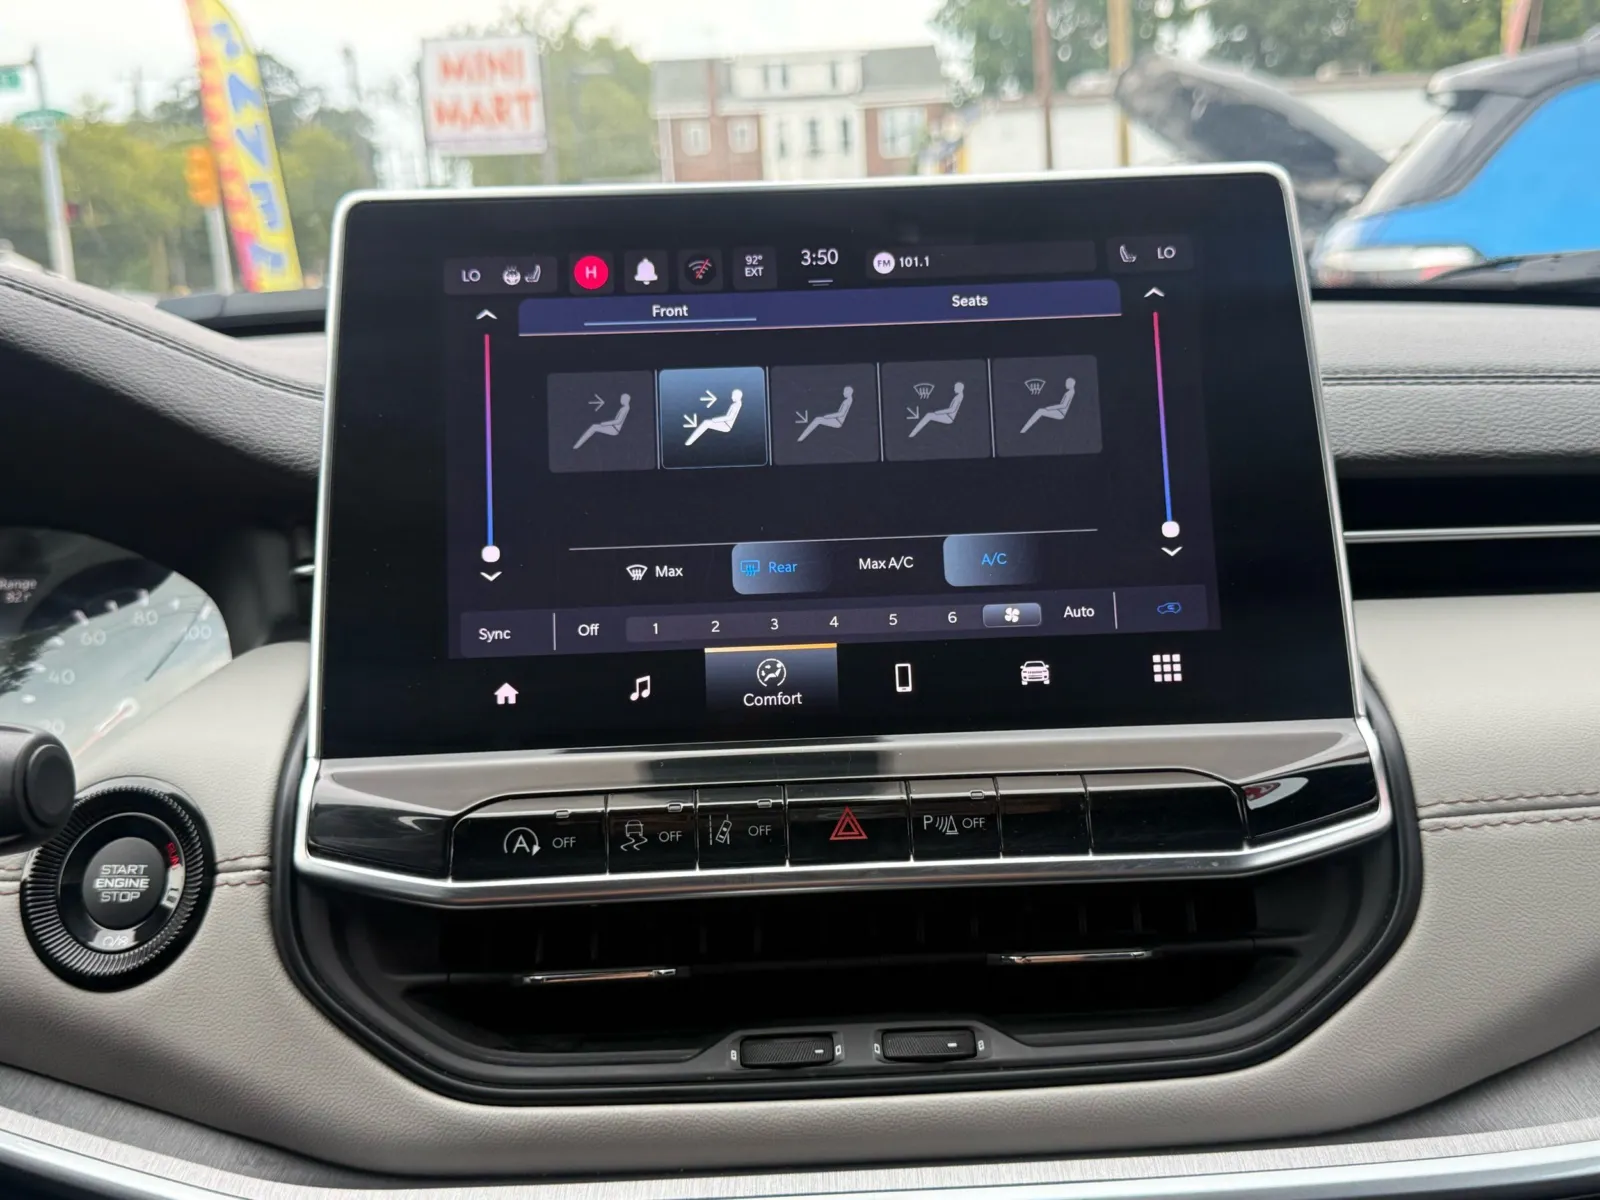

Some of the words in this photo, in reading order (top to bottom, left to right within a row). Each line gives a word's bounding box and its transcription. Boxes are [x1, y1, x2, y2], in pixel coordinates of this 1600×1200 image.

[438, 50, 526, 81] MINI
[431, 91, 537, 130] MART
[800, 248, 839, 269] 3:50
[1157, 245, 1176, 260] LO
[876, 259, 892, 269] FM
[898, 256, 930, 269] 101.1
[461, 270, 481, 283] LO
[744, 266, 764, 278] EXT
[951, 295, 988, 307] Seats
[652, 304, 689, 318] Front
[859, 558, 886, 570] Max
[887, 556, 914, 570] A/C
[981, 552, 1008, 567] A/C
[655, 565, 683, 579] Max
[768, 560, 798, 574] Rear
[133, 610, 158, 626] 80
[948, 611, 958, 624] 6
[1063, 605, 1095, 619] Auto
[770, 618, 779, 631] 3
[829, 616, 839, 629] 4
[889, 613, 898, 626] 5
[577, 623, 601, 637] Off
[652, 623, 660, 635] 1
[711, 620, 721, 633] 2
[80, 629, 107, 646] 60
[478, 627, 511, 643] Sync
[49, 669, 75, 685] 40
[743, 692, 802, 706] Comfort
[923, 815, 933, 830] P
[962, 816, 985, 829] OFF
[658, 830, 682, 843] OFF
[748, 824, 771, 837] OFF
[552, 836, 576, 849] OFF
[101, 864, 149, 875] START
[93, 877, 151, 889] ENGINE
[101, 891, 141, 903] STOP
